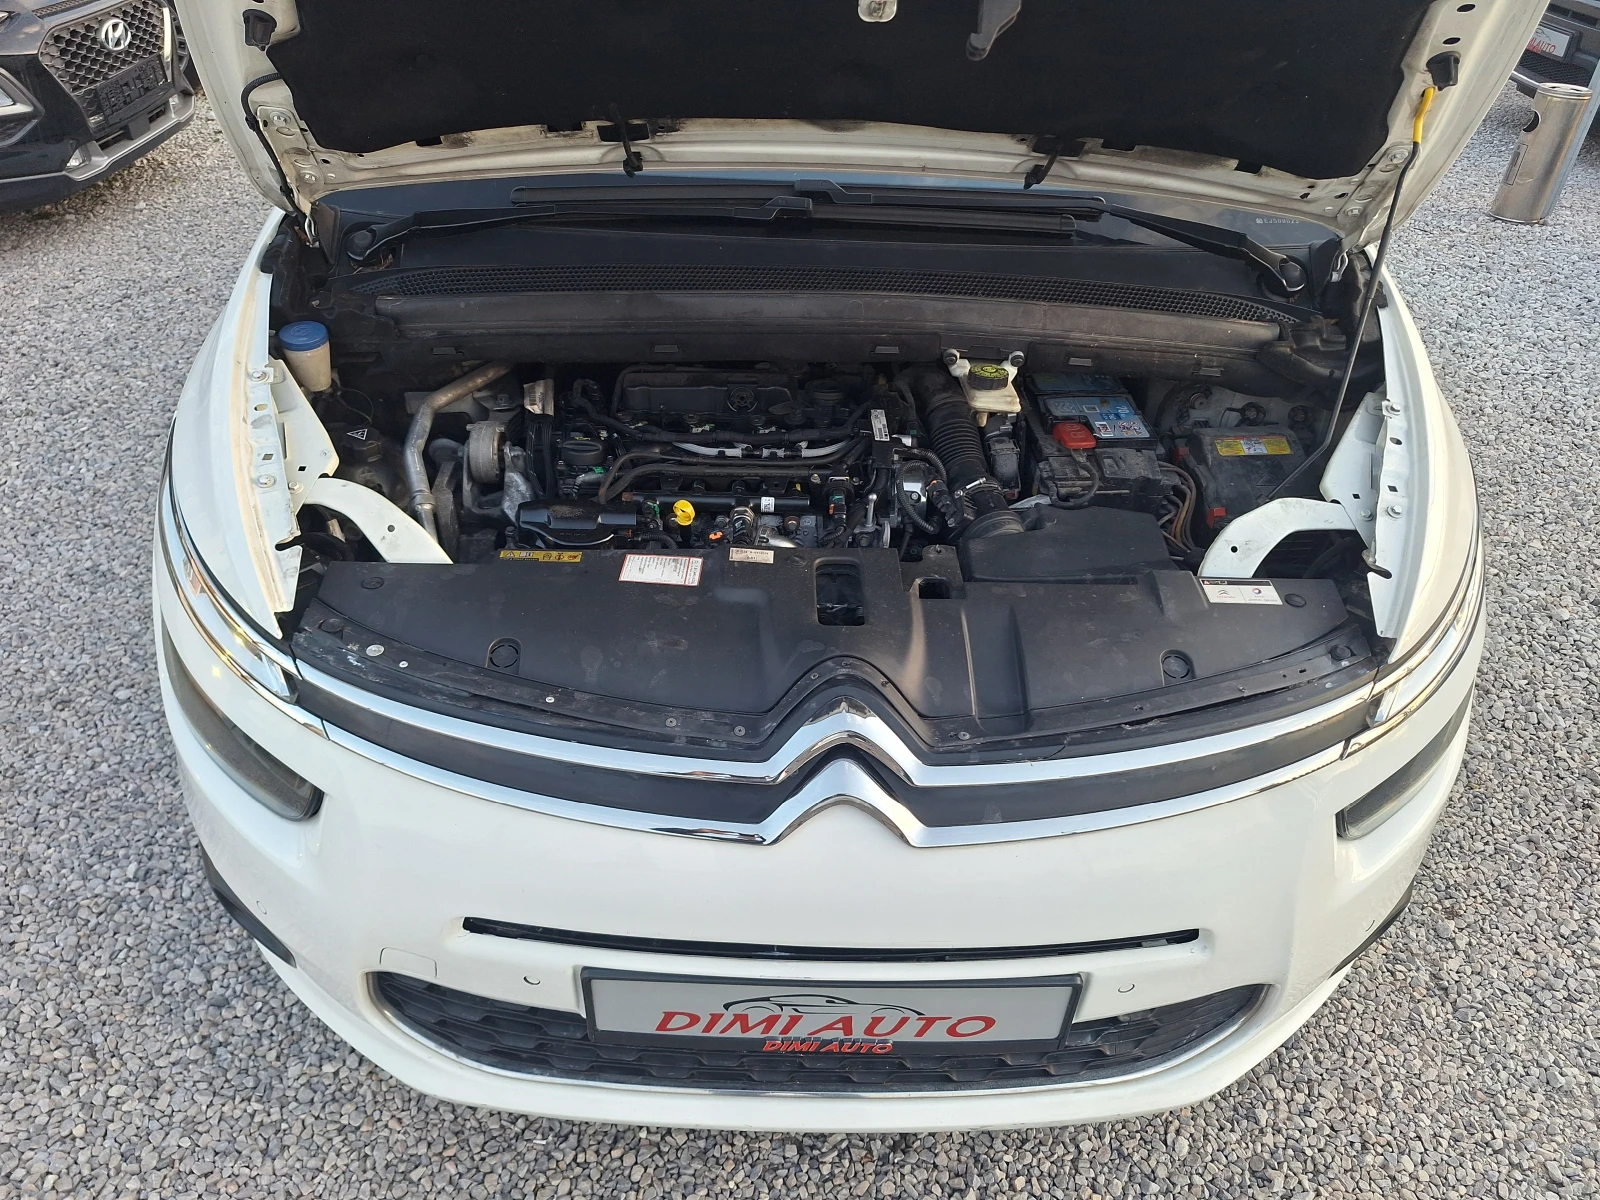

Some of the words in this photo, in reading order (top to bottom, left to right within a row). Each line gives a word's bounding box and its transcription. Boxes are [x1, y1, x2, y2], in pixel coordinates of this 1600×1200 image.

[1535, 40, 1556, 54] AUTO
[654, 1011, 811, 1036] DIMI
[807, 1014, 997, 1038] AUTO
[762, 1040, 820, 1052] DIMI
[820, 1041, 893, 1054] AUTO
